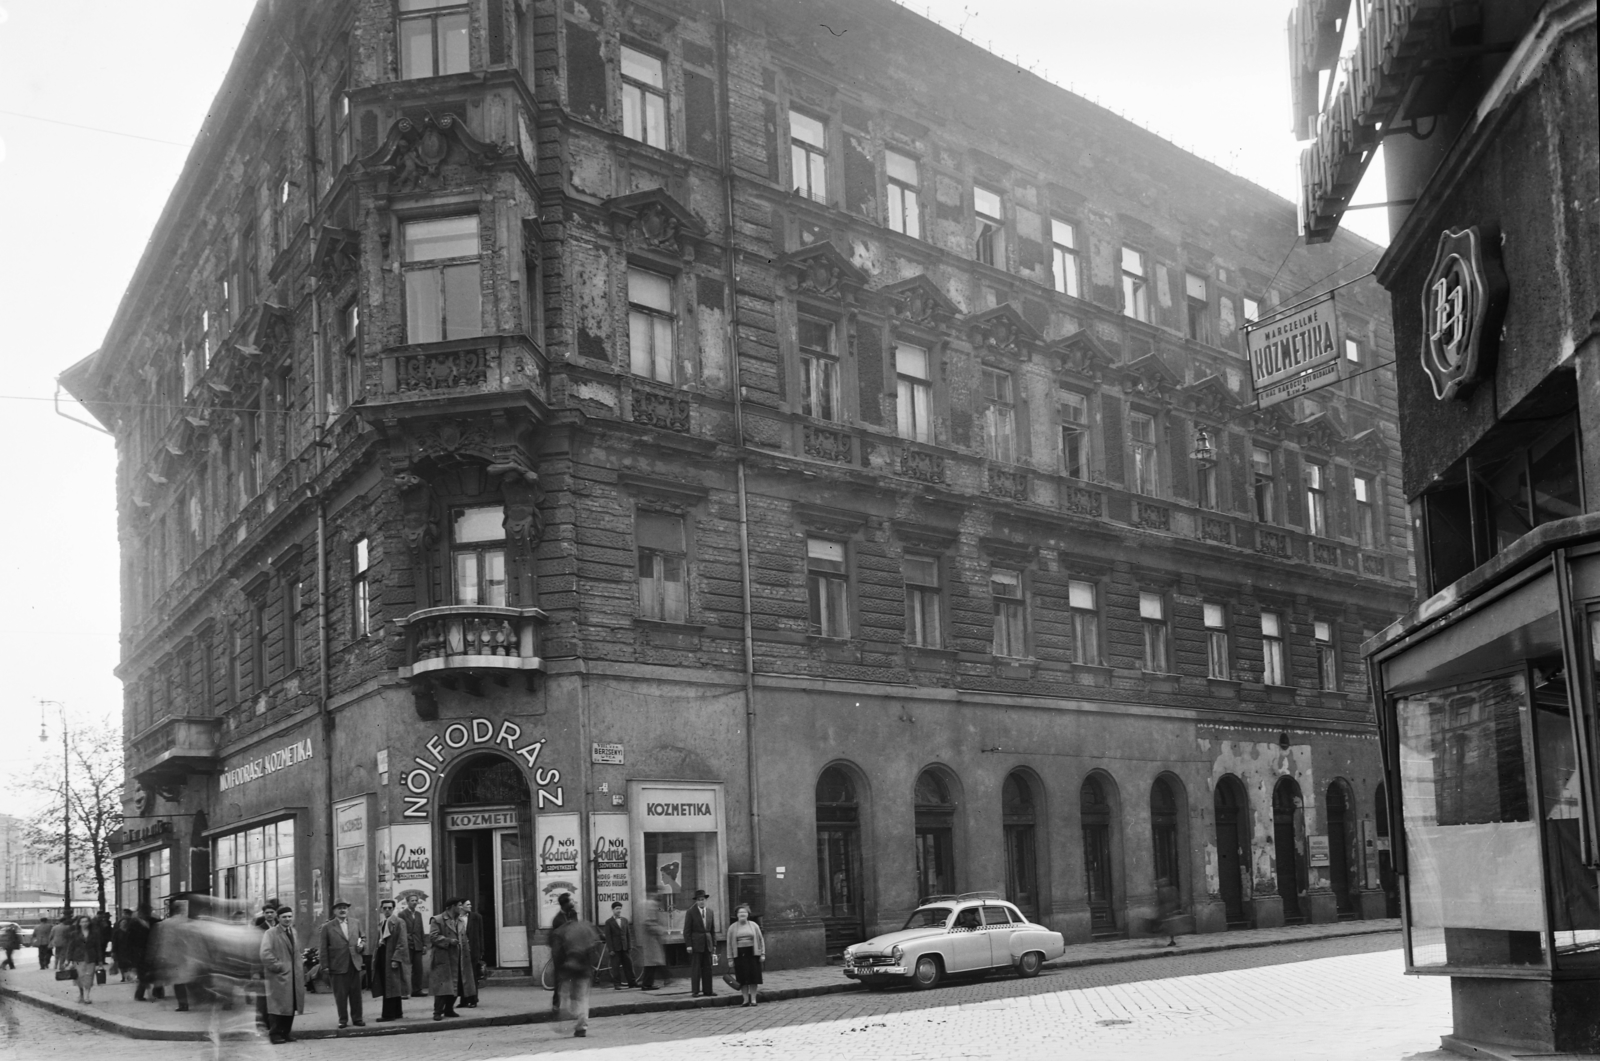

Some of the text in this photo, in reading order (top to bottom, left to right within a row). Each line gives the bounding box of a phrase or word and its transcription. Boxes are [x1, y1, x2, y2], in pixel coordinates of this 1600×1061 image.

[1264, 310, 1319, 341] MARCZELLNÉ
[1254, 321, 1335, 381] KOZMETIKA
[264, 738, 313, 775] KOZMETIKA
[400, 757, 437, 818] NŐI
[426, 718, 563, 809] FODRÁSZ
[647, 803, 712, 816] KOZMETIKA
[558, 838, 575, 847] NŐI
[608, 838, 624, 848] NŐI
[410, 846, 426, 856] NŐI
[598, 893, 629, 902] OZMETIKA
